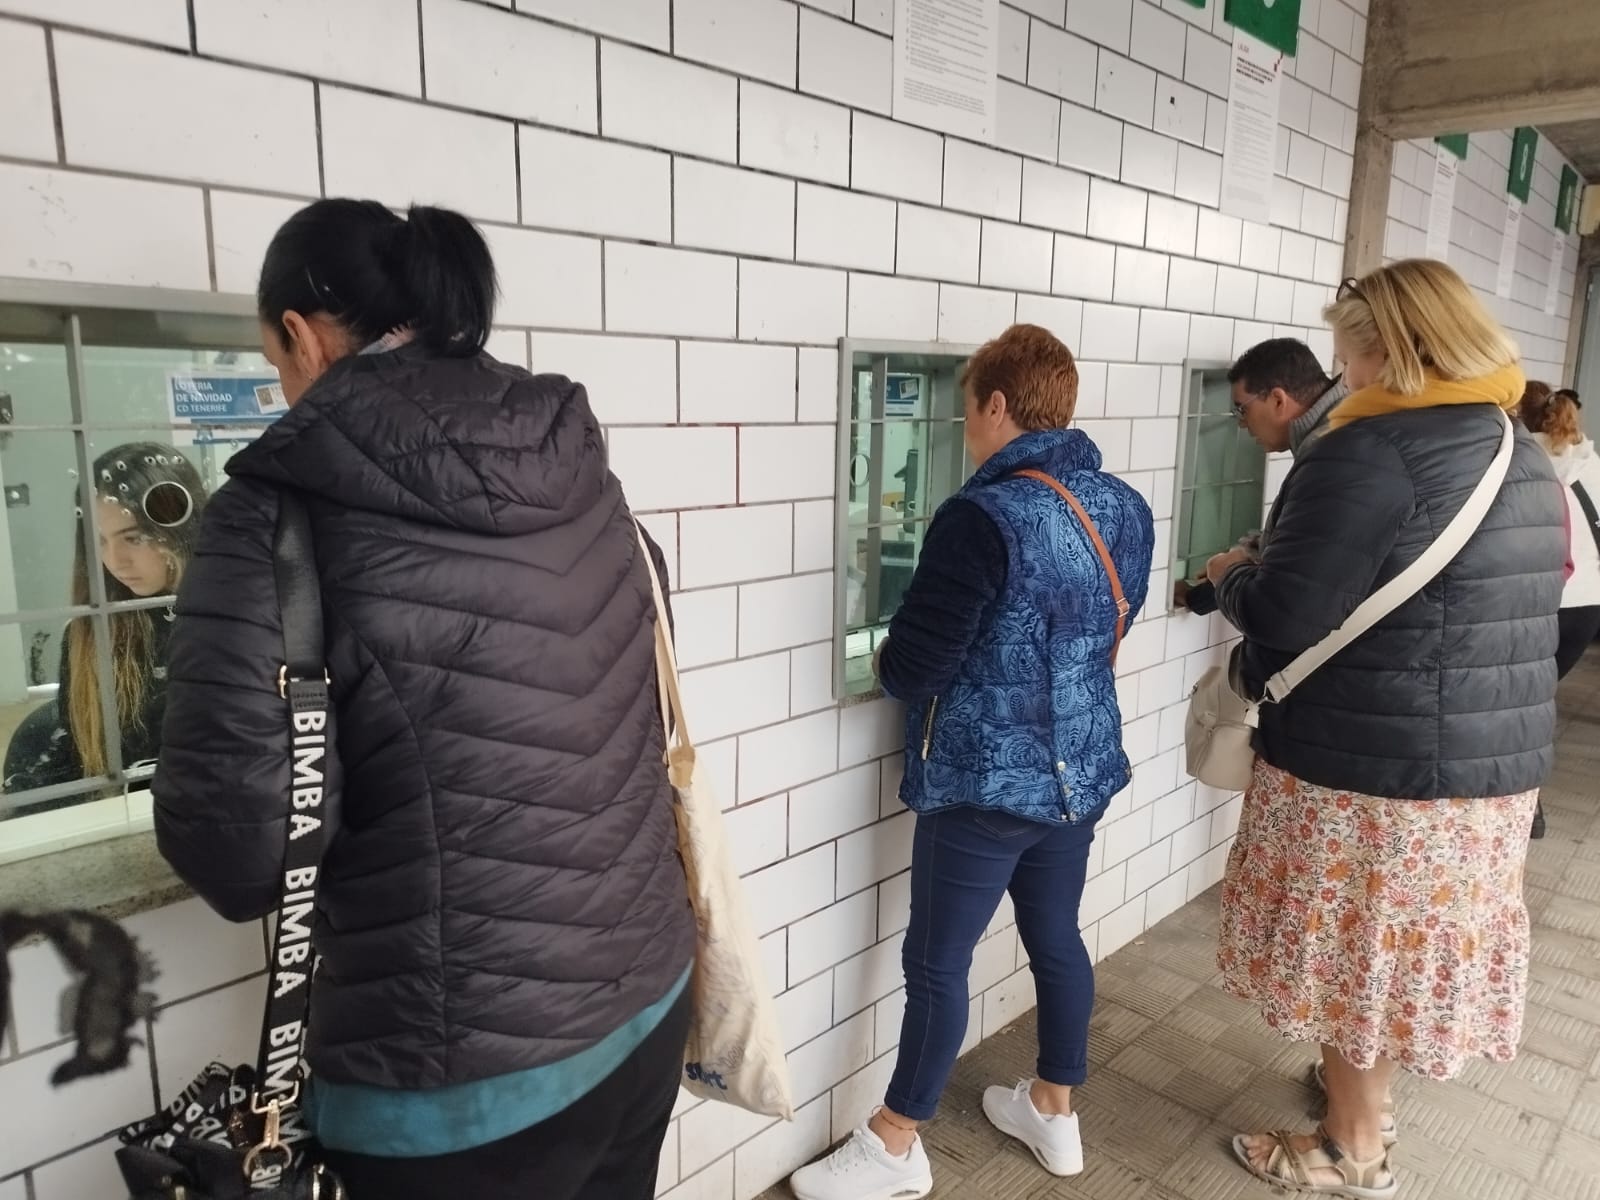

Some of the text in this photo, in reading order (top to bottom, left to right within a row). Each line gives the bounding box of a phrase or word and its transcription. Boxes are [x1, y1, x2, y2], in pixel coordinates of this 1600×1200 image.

[175, 393, 232, 402] DE NAVIDAD
[177, 404, 227, 412] CD TENERIFE
[289, 710, 327, 841] BIMBA
[274, 865, 318, 998] BIMBA
